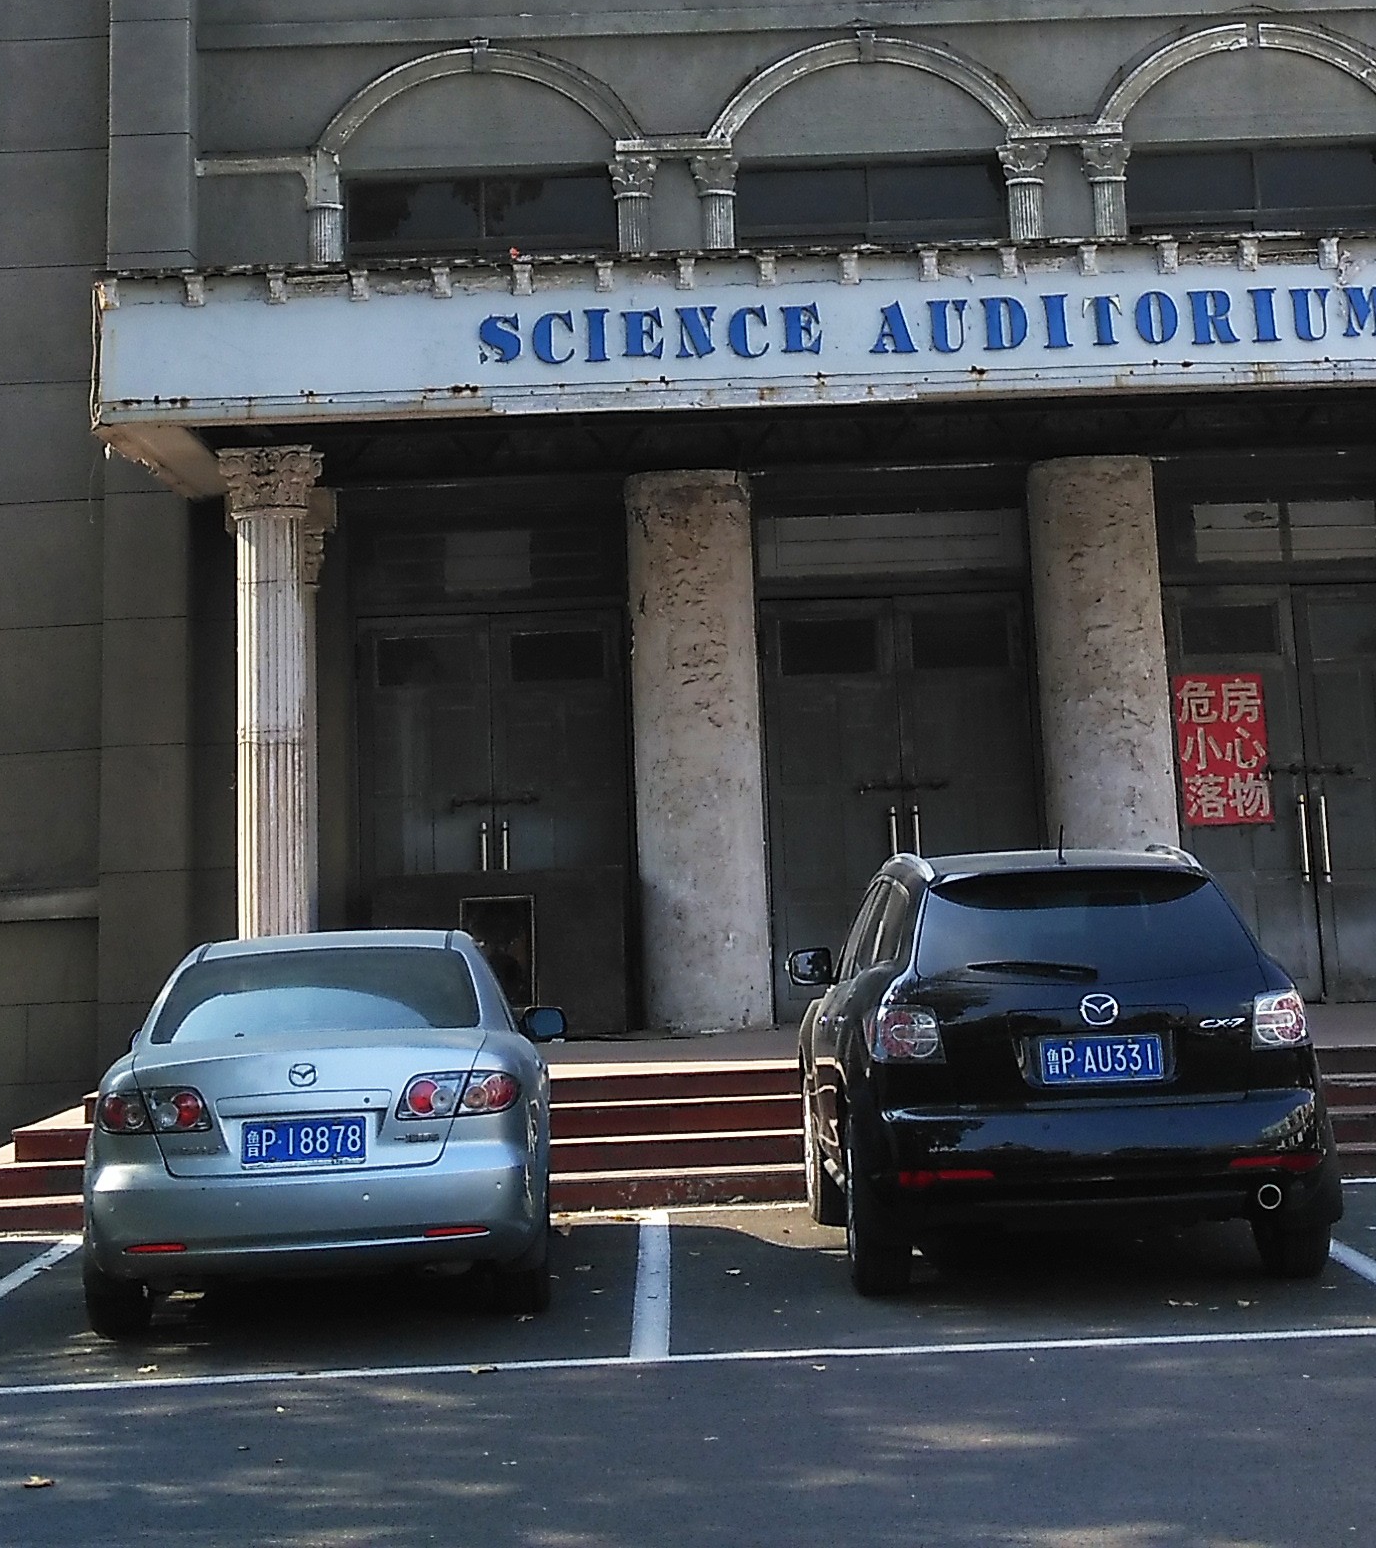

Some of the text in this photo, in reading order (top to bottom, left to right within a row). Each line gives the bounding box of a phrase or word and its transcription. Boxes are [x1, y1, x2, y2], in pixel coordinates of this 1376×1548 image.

[477, 300, 825, 366] SCIENCE
[1176, 677, 1261, 725] 危房
[1181, 726, 1266, 771] 小心
[1184, 771, 1273, 819] 落物
[1199, 1017, 1246, 1029] CX-7
